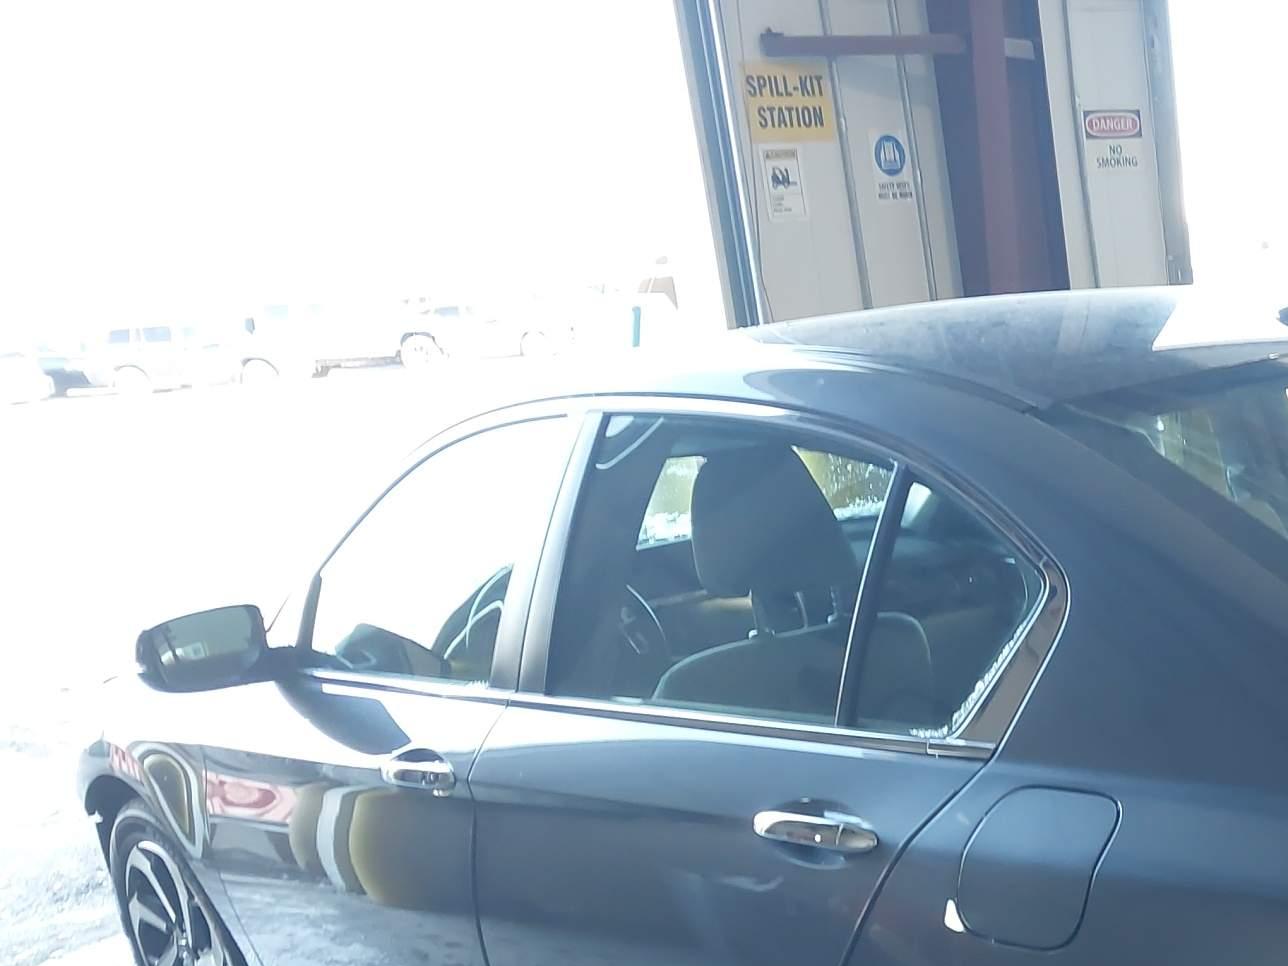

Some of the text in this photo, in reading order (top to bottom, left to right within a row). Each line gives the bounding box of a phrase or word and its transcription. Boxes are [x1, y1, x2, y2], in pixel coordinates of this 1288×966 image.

[745, 74, 824, 98] SPILL-KIT
[757, 104, 824, 128] STATION
[1092, 116, 1134, 131] DANGER
[1108, 144, 1123, 156] NO
[1096, 155, 1138, 169] SMOKING
